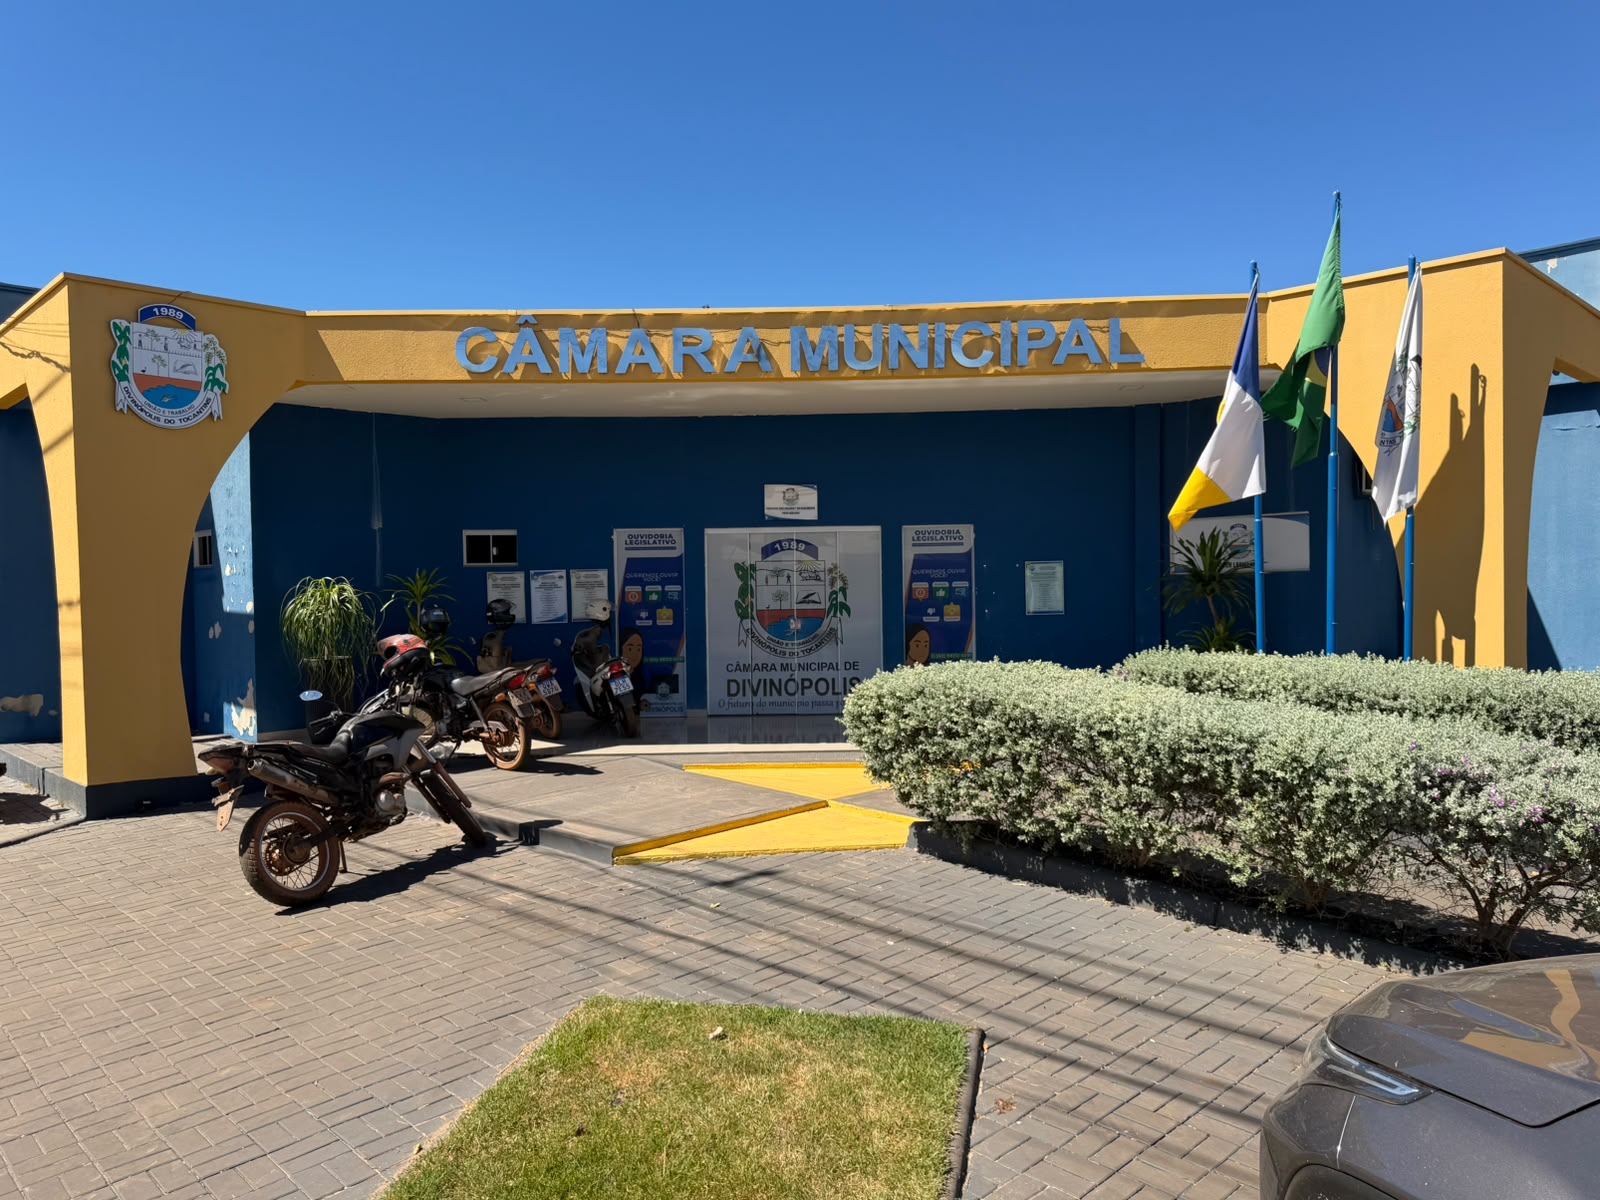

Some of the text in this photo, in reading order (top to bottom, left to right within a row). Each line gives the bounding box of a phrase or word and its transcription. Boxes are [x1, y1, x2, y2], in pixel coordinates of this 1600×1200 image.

[152, 307, 184, 320] 1989
[455, 314, 1146, 375] CÂMARA MUNICIPAL
[178, 397, 212, 424] TOCANTINS
[624, 538, 677, 546] LEGISLATIVO
[911, 534, 964, 542] LEGISLATIVO
[774, 541, 806, 552] 1989
[801, 626, 836, 655] TOCANTINS
[725, 661, 860, 674] CÂMARA MUNICIPAL DE
[718, 699, 726, 709] O
[756, 698, 767, 708] do
